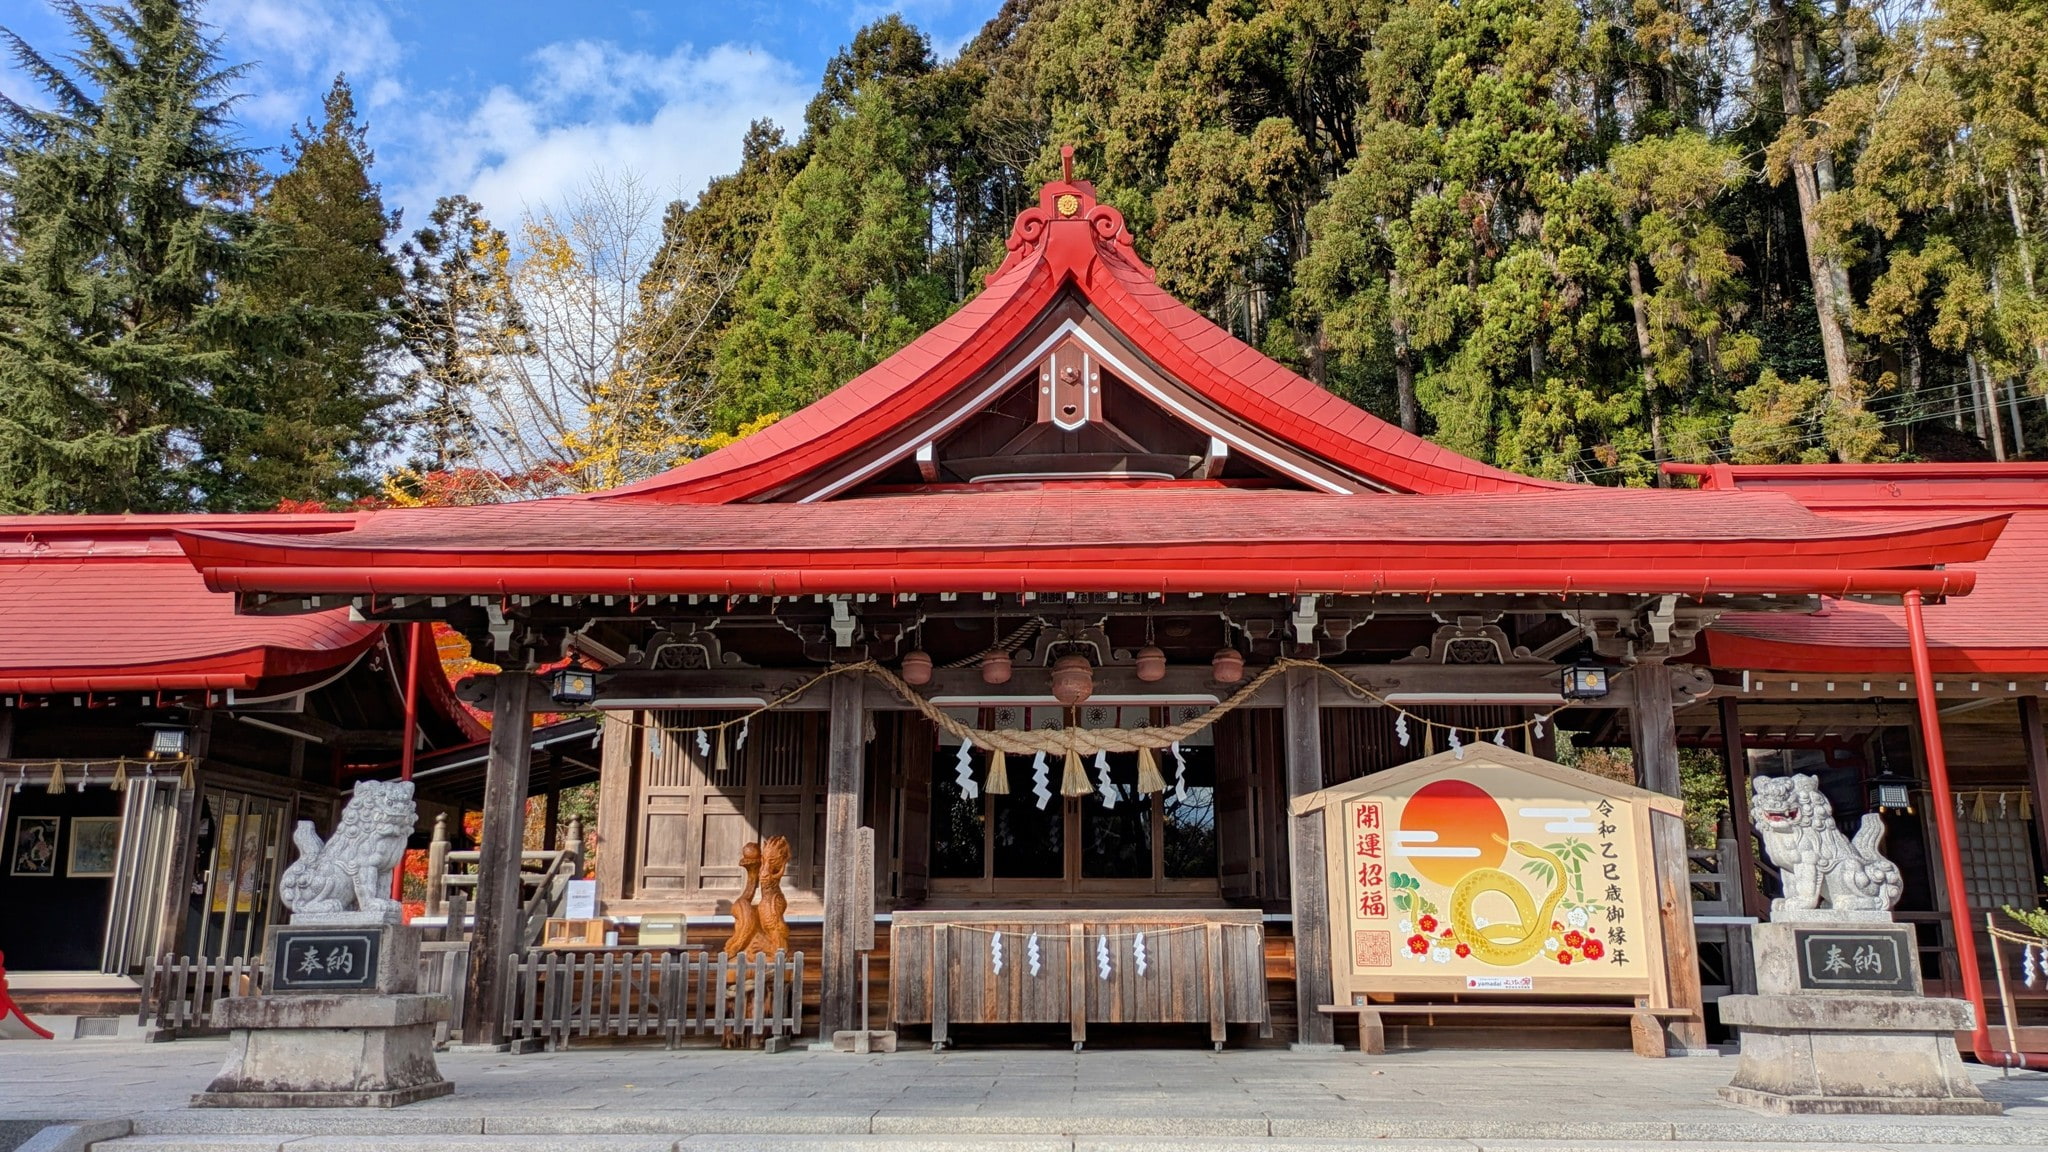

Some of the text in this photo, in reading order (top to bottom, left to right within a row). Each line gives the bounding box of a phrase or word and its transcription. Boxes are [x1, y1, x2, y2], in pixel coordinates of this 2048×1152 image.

[1356, 804, 1385, 917] 開運招福
[1596, 798, 1630, 967] 令和乙巳歳御縁年
[296, 945, 353, 975] 奉納
[1821, 943, 1882, 975] 奉納
